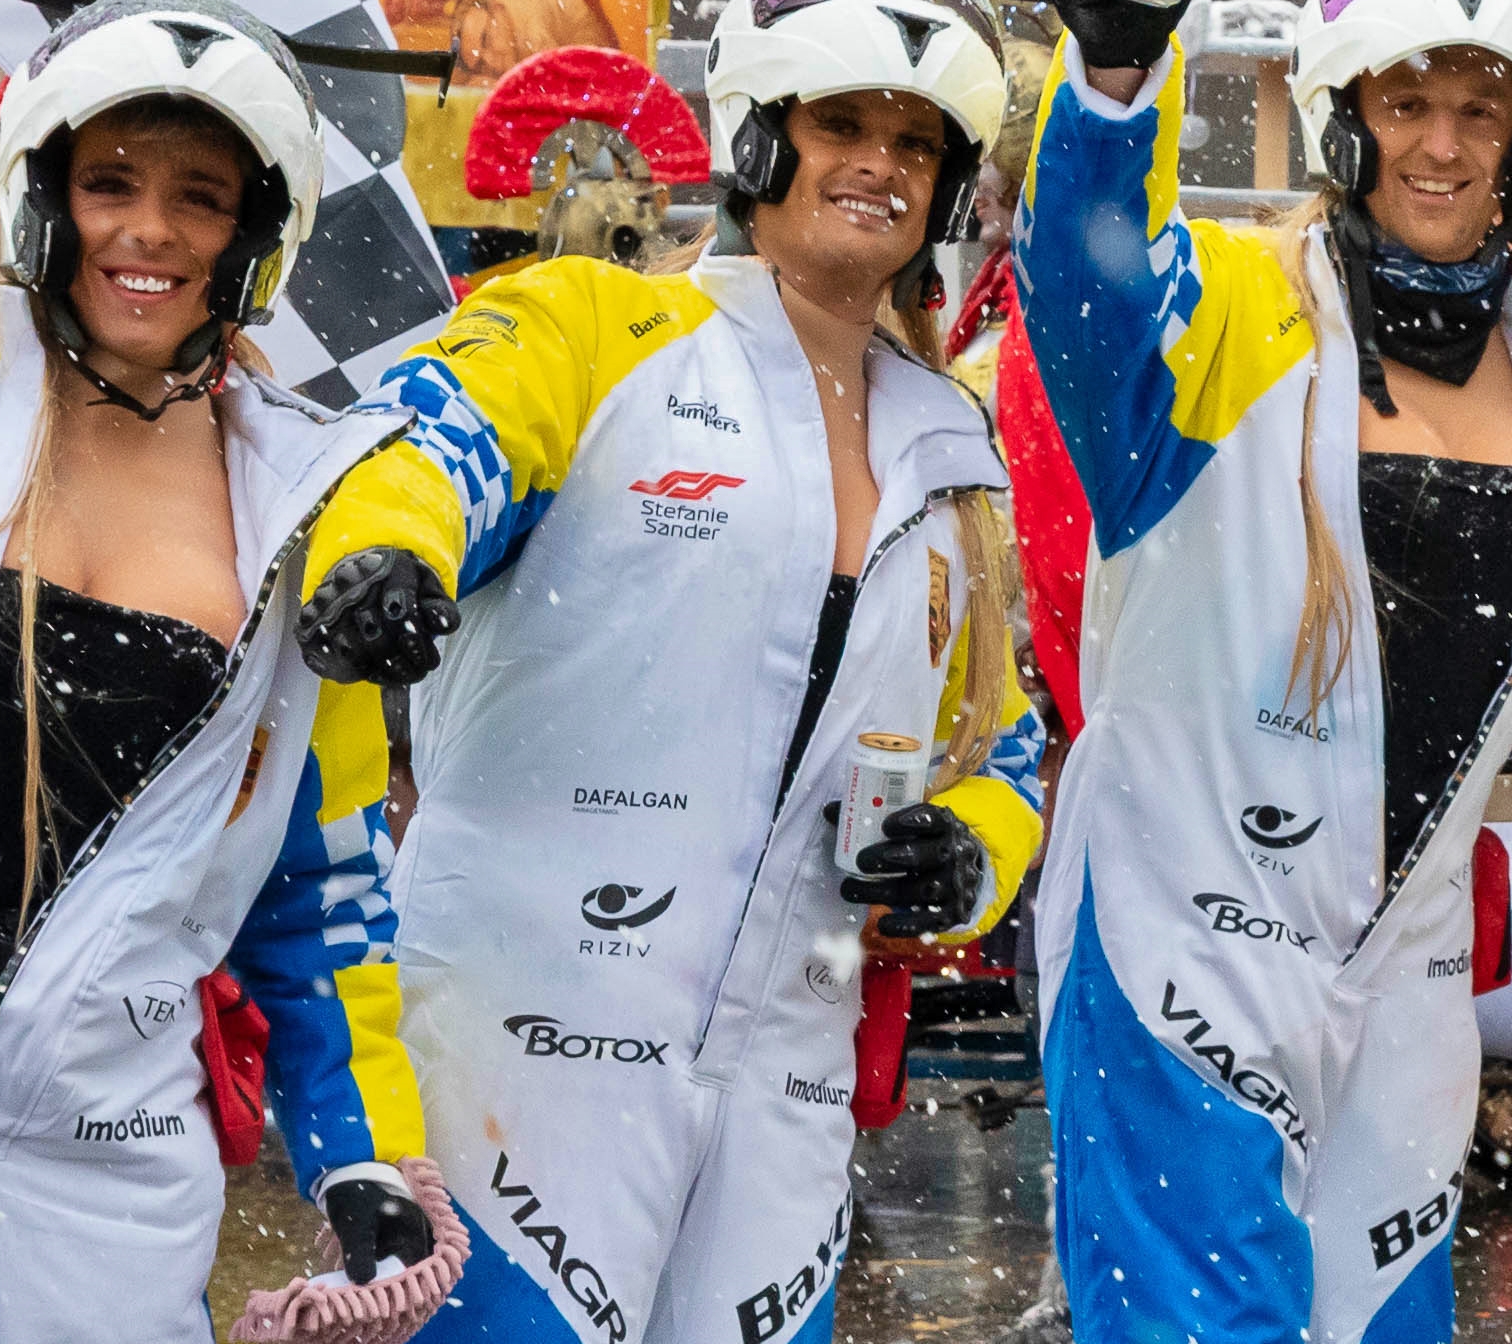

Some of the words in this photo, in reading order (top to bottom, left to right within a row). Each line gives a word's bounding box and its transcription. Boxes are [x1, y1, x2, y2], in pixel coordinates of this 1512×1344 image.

[667, 394, 742, 435] Pampers
[641, 500, 729, 524] Stefanie
[643, 520, 721, 541] Sander
[573, 787, 688, 811] DAFALGAN
[580, 940, 651, 958] RIZIV
[525, 1024, 669, 1066] BOTOX
[74, 1108, 186, 1143] Imodium
